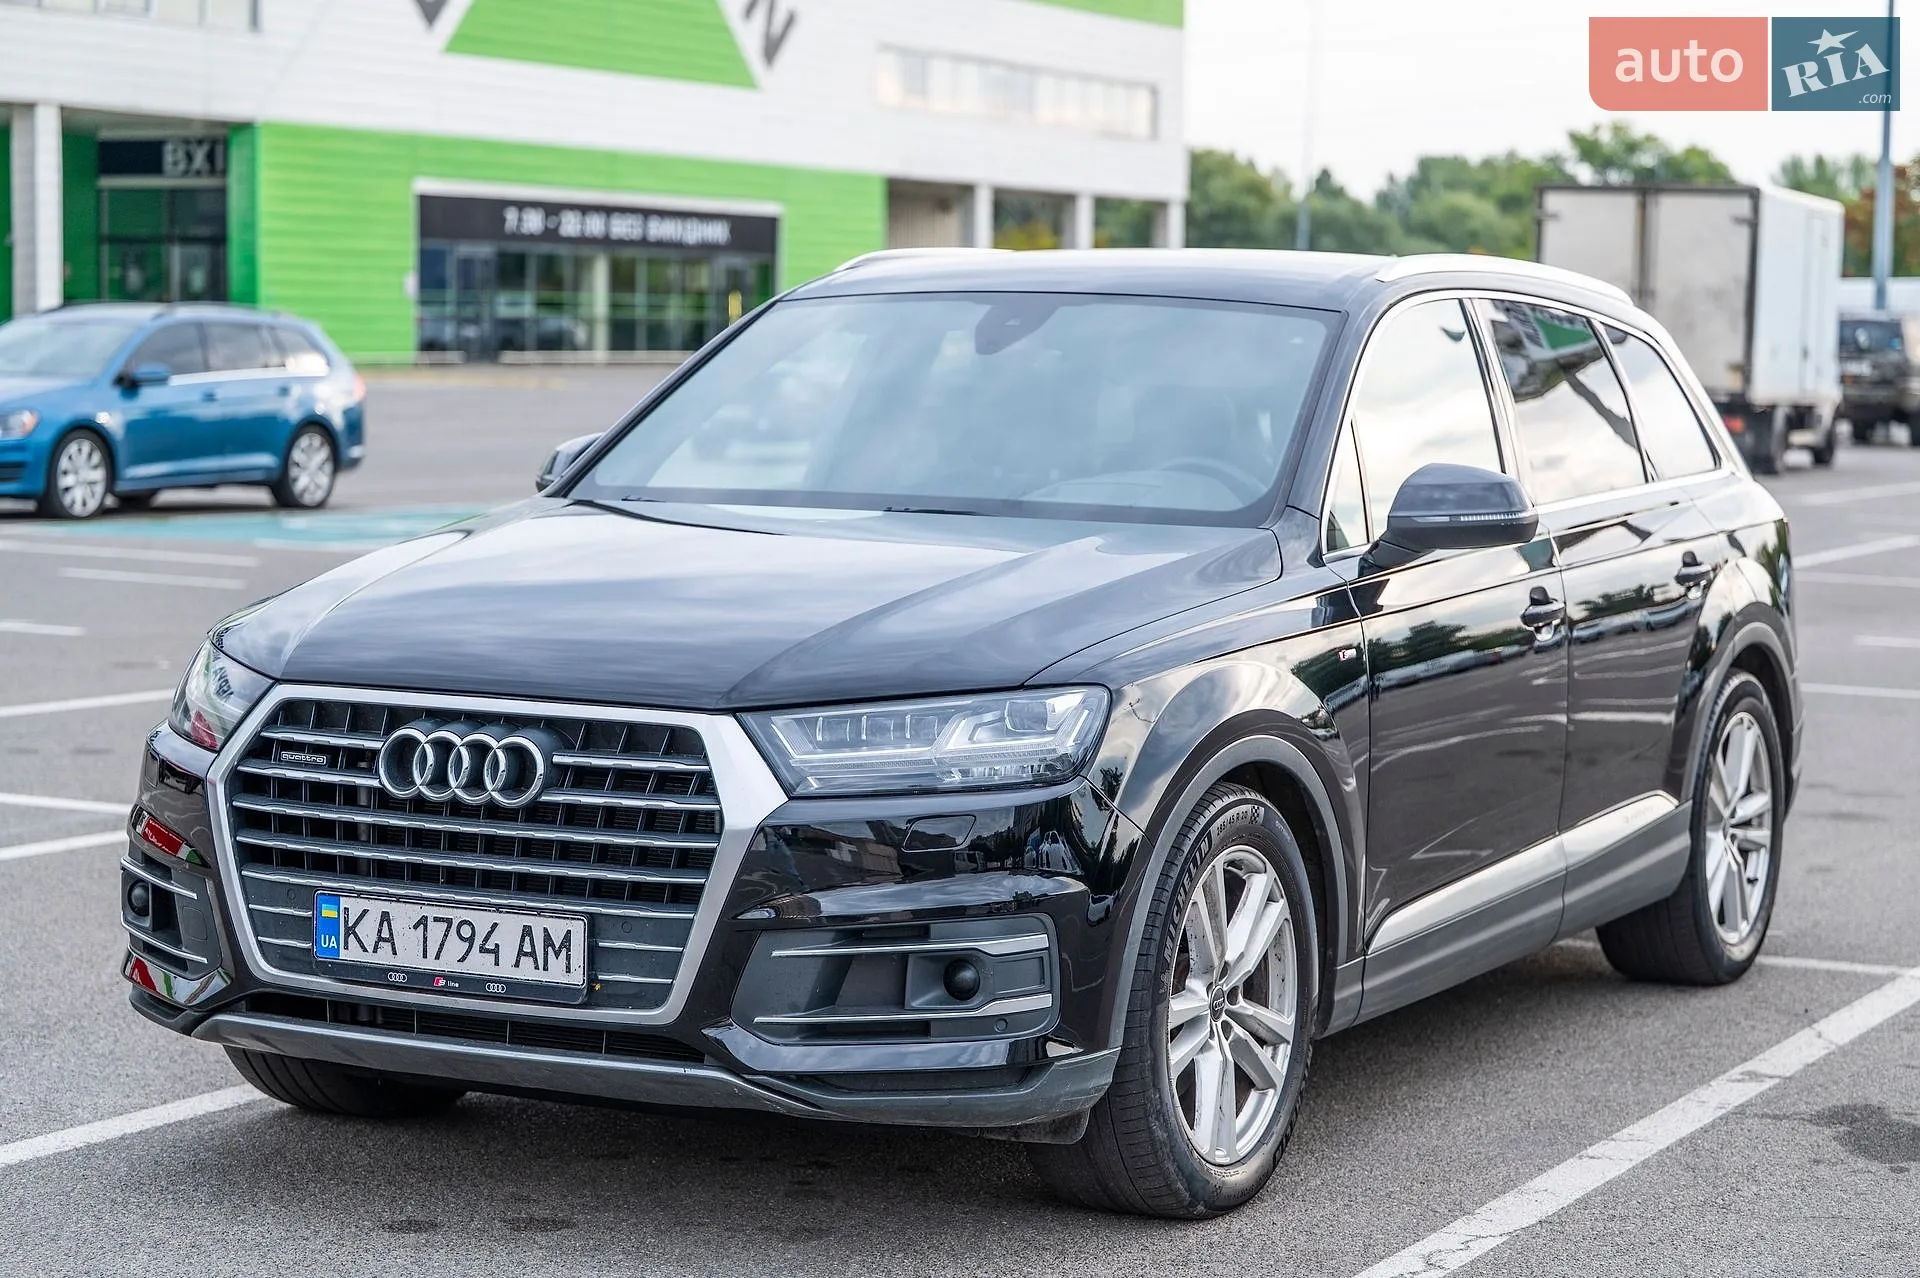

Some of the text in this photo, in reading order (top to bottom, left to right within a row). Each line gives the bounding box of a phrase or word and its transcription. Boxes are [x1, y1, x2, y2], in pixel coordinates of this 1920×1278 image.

[282, 752, 324, 763] quattro
[1164, 833, 1211, 963] MICHELIN
[321, 934, 338, 949] UA
[343, 907, 572, 974] KA 1794 AM
[447, 980, 460, 988] line
